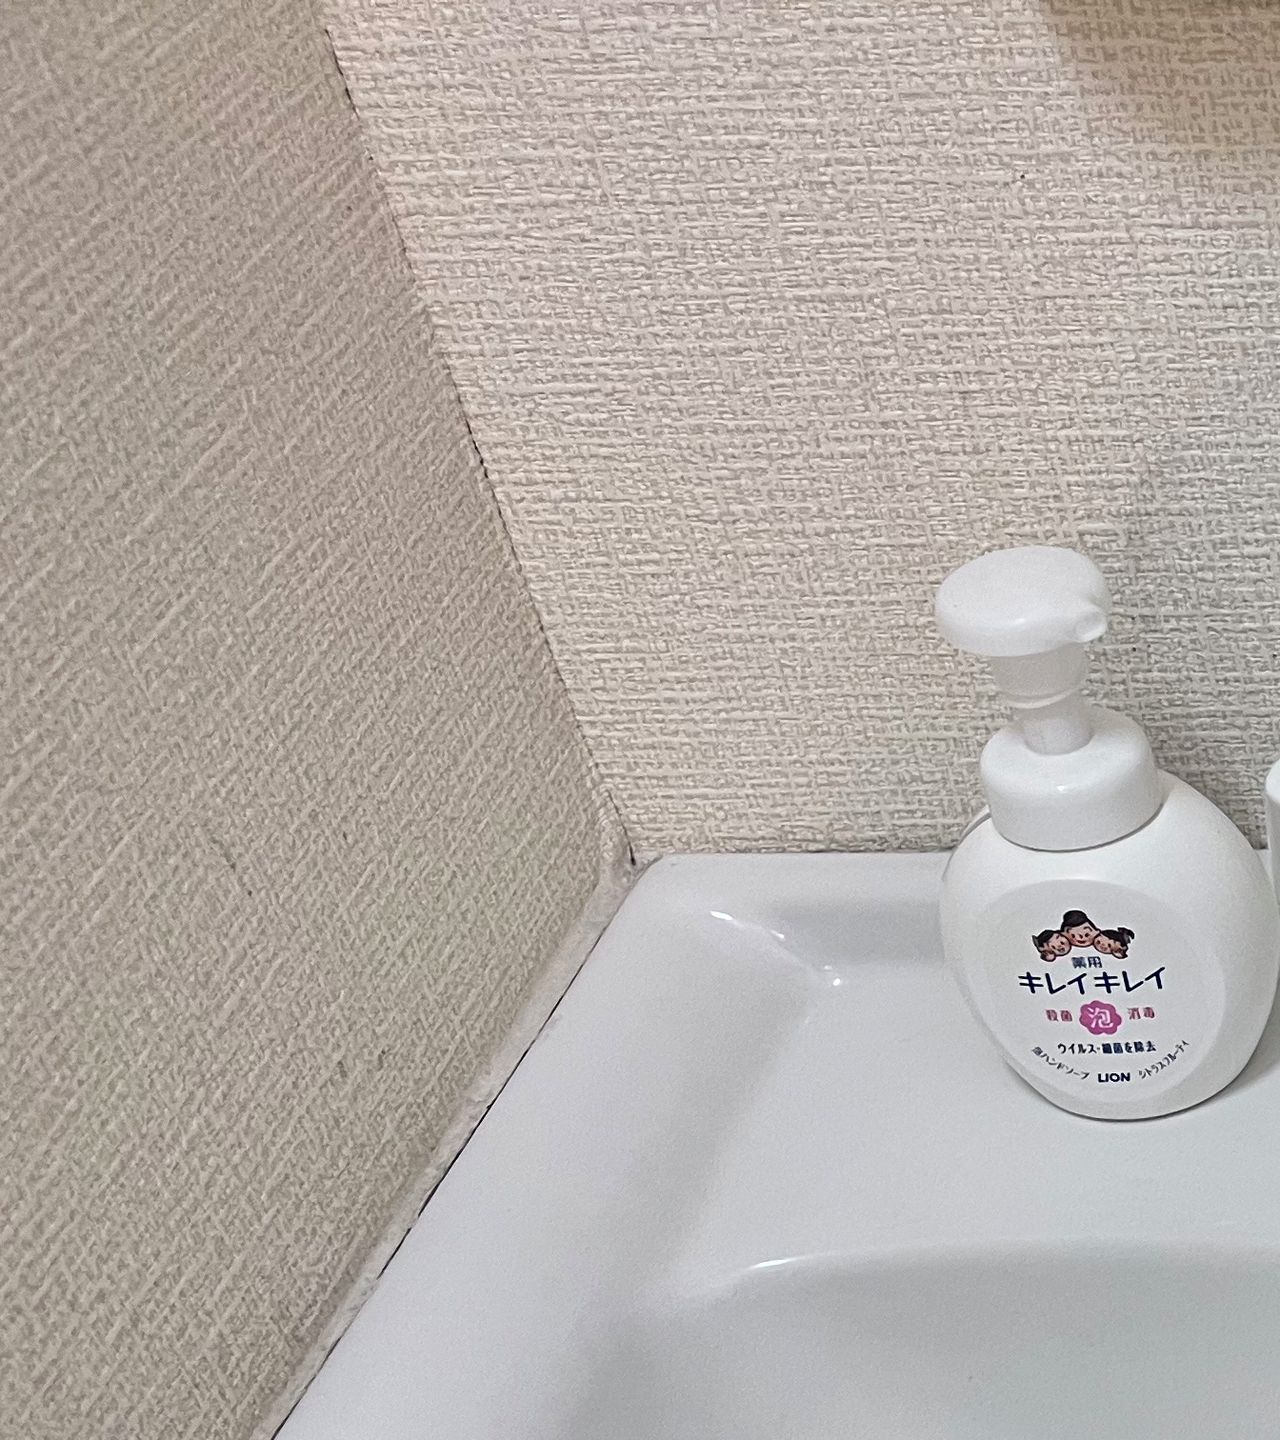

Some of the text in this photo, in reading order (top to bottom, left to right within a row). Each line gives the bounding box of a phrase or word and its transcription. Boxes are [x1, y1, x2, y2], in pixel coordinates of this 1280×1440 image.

[1071, 956, 1103, 969] 薬用
[1018, 967, 1166, 995] キレイキレイ
[1087, 1007, 1114, 1028] 泡
[1127, 1006, 1156, 1020] 消毒
[1097, 1072, 1131, 1083] LION
